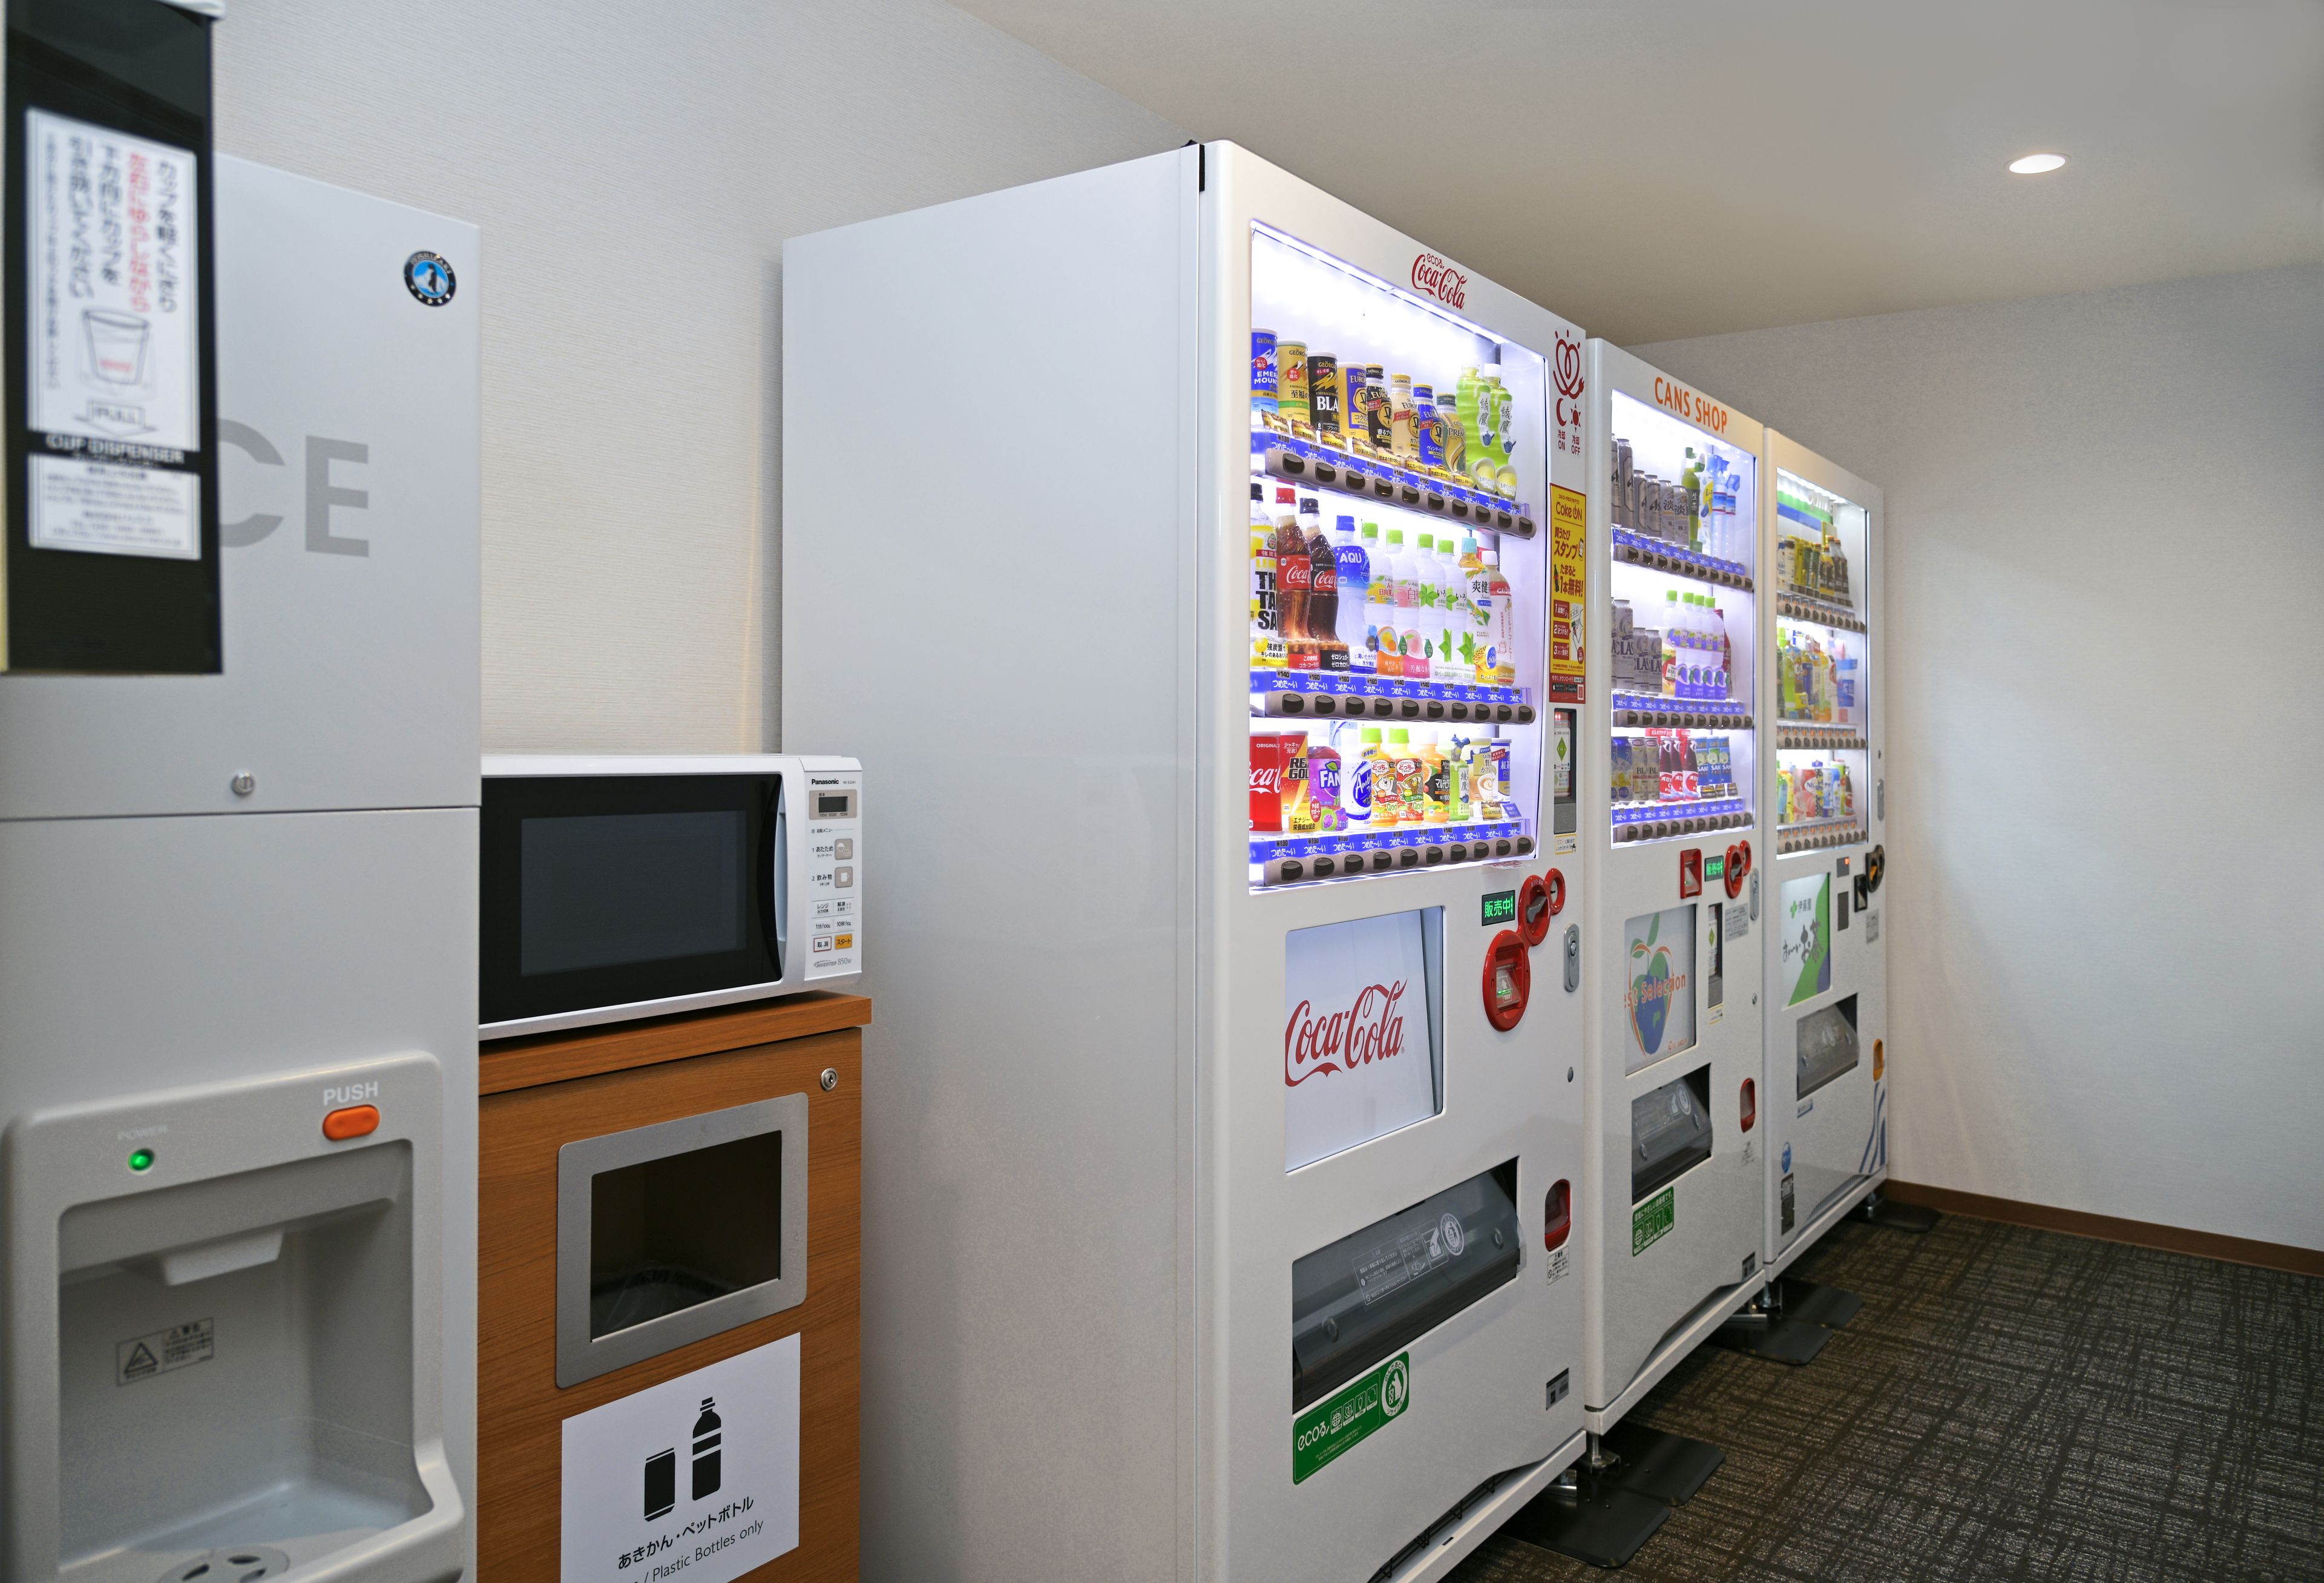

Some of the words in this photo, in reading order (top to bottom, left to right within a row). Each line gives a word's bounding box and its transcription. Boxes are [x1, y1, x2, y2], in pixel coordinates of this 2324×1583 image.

[1653, 377, 1691, 417] CANS
[1695, 397, 1728, 434] SHOP
[1558, 440, 1565, 451] ON
[1571, 445, 1581, 456] OFF
[1555, 501, 1572, 518] Coke
[1573, 504, 1583, 522] ON
[1554, 526, 1571, 541] 買うたび
[1554, 540, 1578, 561] スタンプ
[1560, 563, 1576, 576] たまると
[1560, 576, 1583, 597] 1本無料!
[1387, 803, 1398, 812] Qoo
[1484, 898, 1511, 918] 販売中
[1641, 973, 1686, 1004] Selection
[1285, 977, 1408, 1087] Coca-Cola
[323, 1081, 379, 1106] PUSH
[1411, 1465, 1468, 1520] Coca-Cola
[618, 1496, 754, 1570] あきかん・ペットボトル
[652, 1553, 691, 1582] Plastic
[695, 1533, 735, 1562] Bottles
[740, 1519, 764, 1540] only
